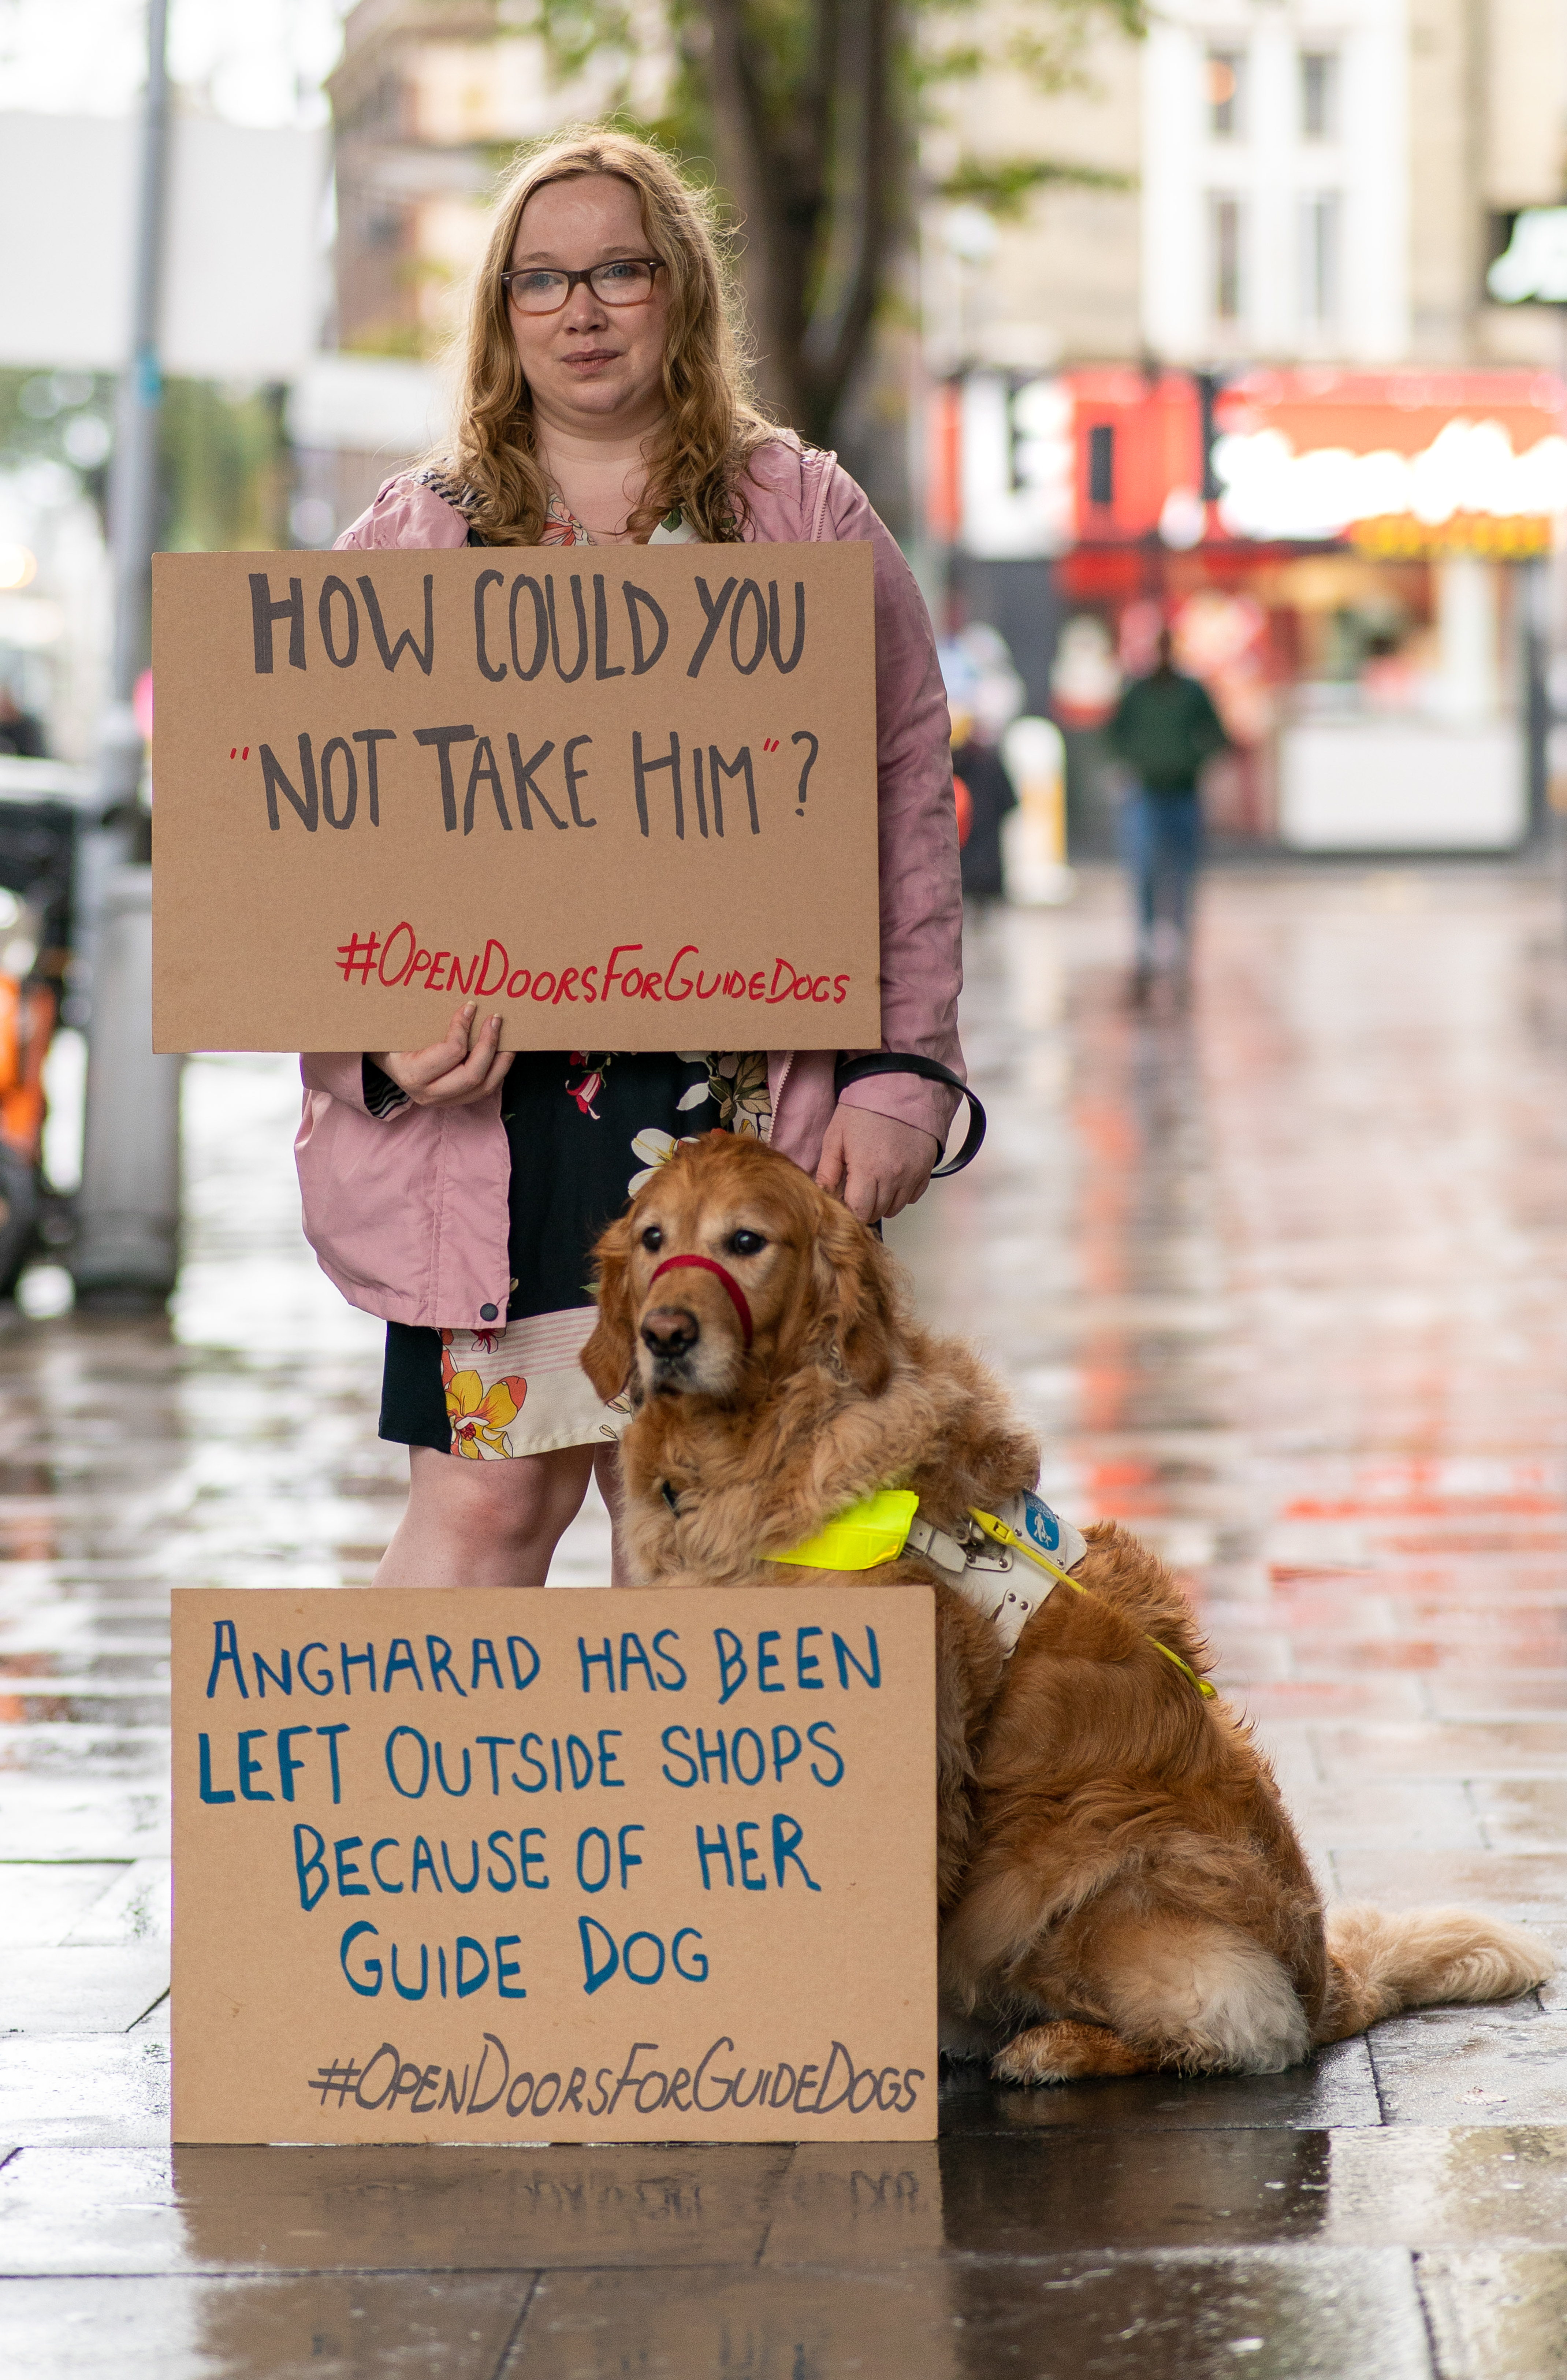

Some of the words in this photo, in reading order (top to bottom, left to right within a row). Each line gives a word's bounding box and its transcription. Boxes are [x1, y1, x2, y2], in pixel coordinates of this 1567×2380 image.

[249, 573, 434, 676] HOW
[474, 569, 669, 684] COULD
[686, 576, 806, 678] YOU
[413, 724, 597, 836] TAKE
[205, 1618, 541, 1700] ANGHARAD
[576, 1628, 688, 1694] HAS
[711, 1625, 882, 1706] BEEN
[197, 1722, 351, 1806] LEFT
[384, 1723, 626, 1800] OUTSIDE
[660, 1720, 846, 1789] SHOPS
[292, 1822, 551, 1913] BECAUSE
[575, 1823, 645, 1895] OF
[695, 1812, 822, 1893] HER
[339, 1919, 528, 2002] GUIDE
[577, 1914, 710, 1996] DOG
